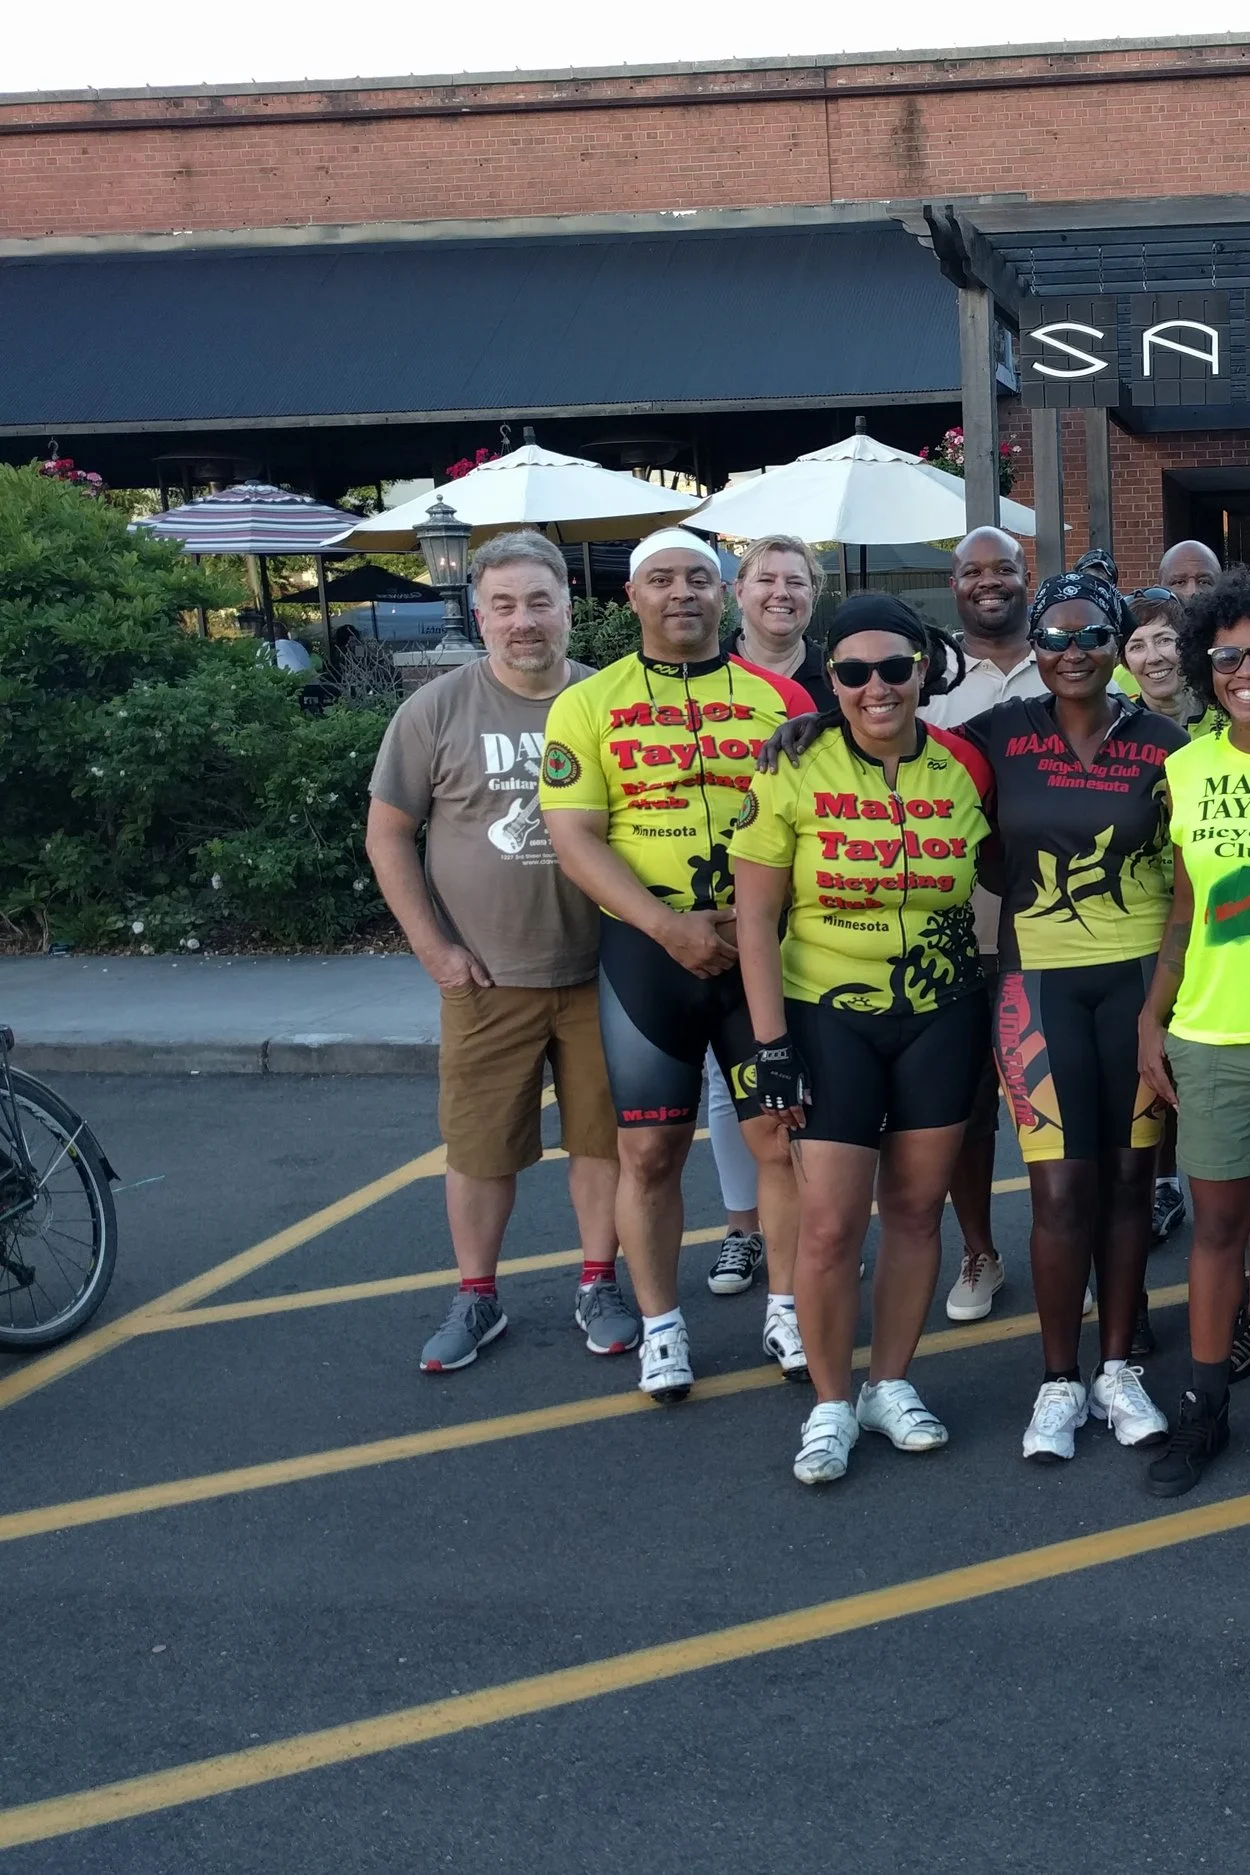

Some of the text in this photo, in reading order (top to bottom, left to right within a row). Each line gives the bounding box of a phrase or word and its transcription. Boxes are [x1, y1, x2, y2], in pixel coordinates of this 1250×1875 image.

[610, 699, 755, 732] Major
[1109, 764, 1141, 778] Club
[488, 777, 538, 791] Guitar
[1047, 774, 1130, 793] Minnesota
[814, 792, 953, 825] Major
[632, 825, 697, 838] Minnesota
[817, 830, 967, 868] Taylor
[816, 870, 956, 894] Bicycling
[818, 894, 885, 910] Club
[823, 914, 890, 932] Minnesota
[999, 972, 1037, 1127] MAJOR TAYLOR
[621, 1106, 689, 1122] Major
